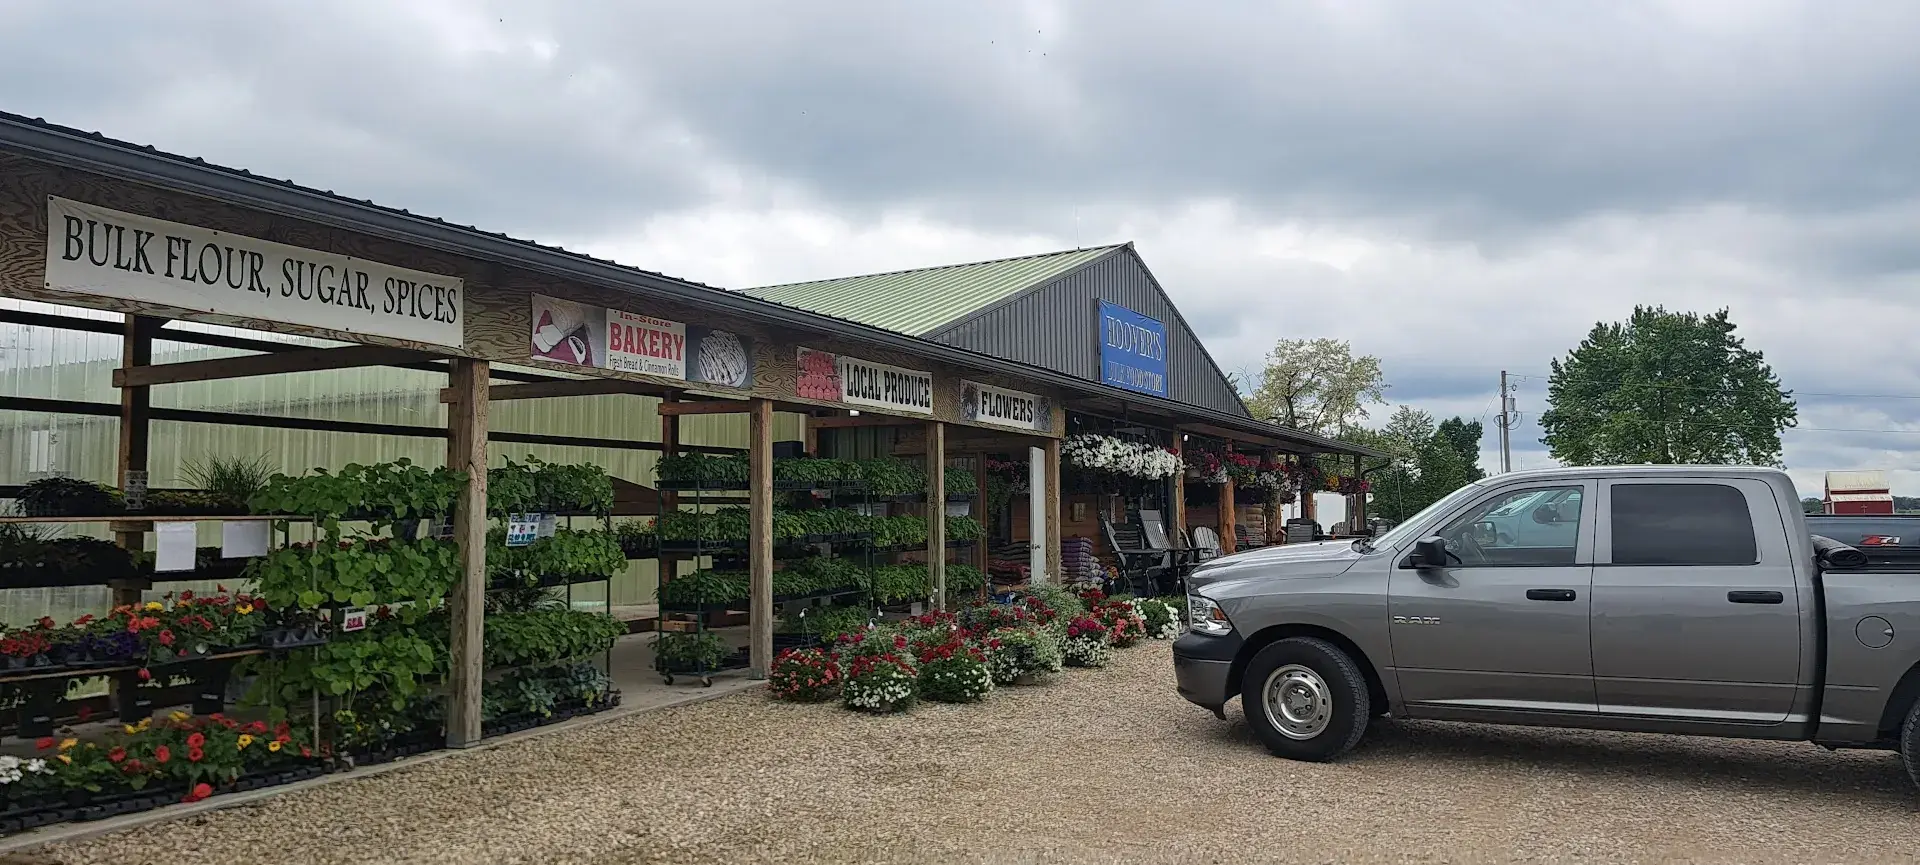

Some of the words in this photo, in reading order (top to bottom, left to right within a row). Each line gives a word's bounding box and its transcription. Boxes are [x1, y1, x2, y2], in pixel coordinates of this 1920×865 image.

[62, 214, 155, 275] BULK
[164, 235, 271, 298] FLOUR,
[281, 257, 375, 315] SUGAR,
[383, 276, 457, 324] SPICES
[619, 311, 672, 328] In-Store
[609, 321, 684, 362] BAKERY
[1106, 315, 1162, 361] HOOVER'S
[609, 354, 623, 368] Fresh
[623, 356, 638, 371] Bread
[638, 359, 644, 371] &
[644, 359, 668, 375] Cinnamon
[668, 363, 680, 377] Rolls
[846, 363, 881, 399] LOCAL
[883, 370, 931, 408] PRODUCE
[1144, 370, 1163, 393] STORE
[981, 391, 1034, 423] FLOWERS
[1860, 534, 1901, 546] Z71
[1393, 615, 1441, 625] RAM
